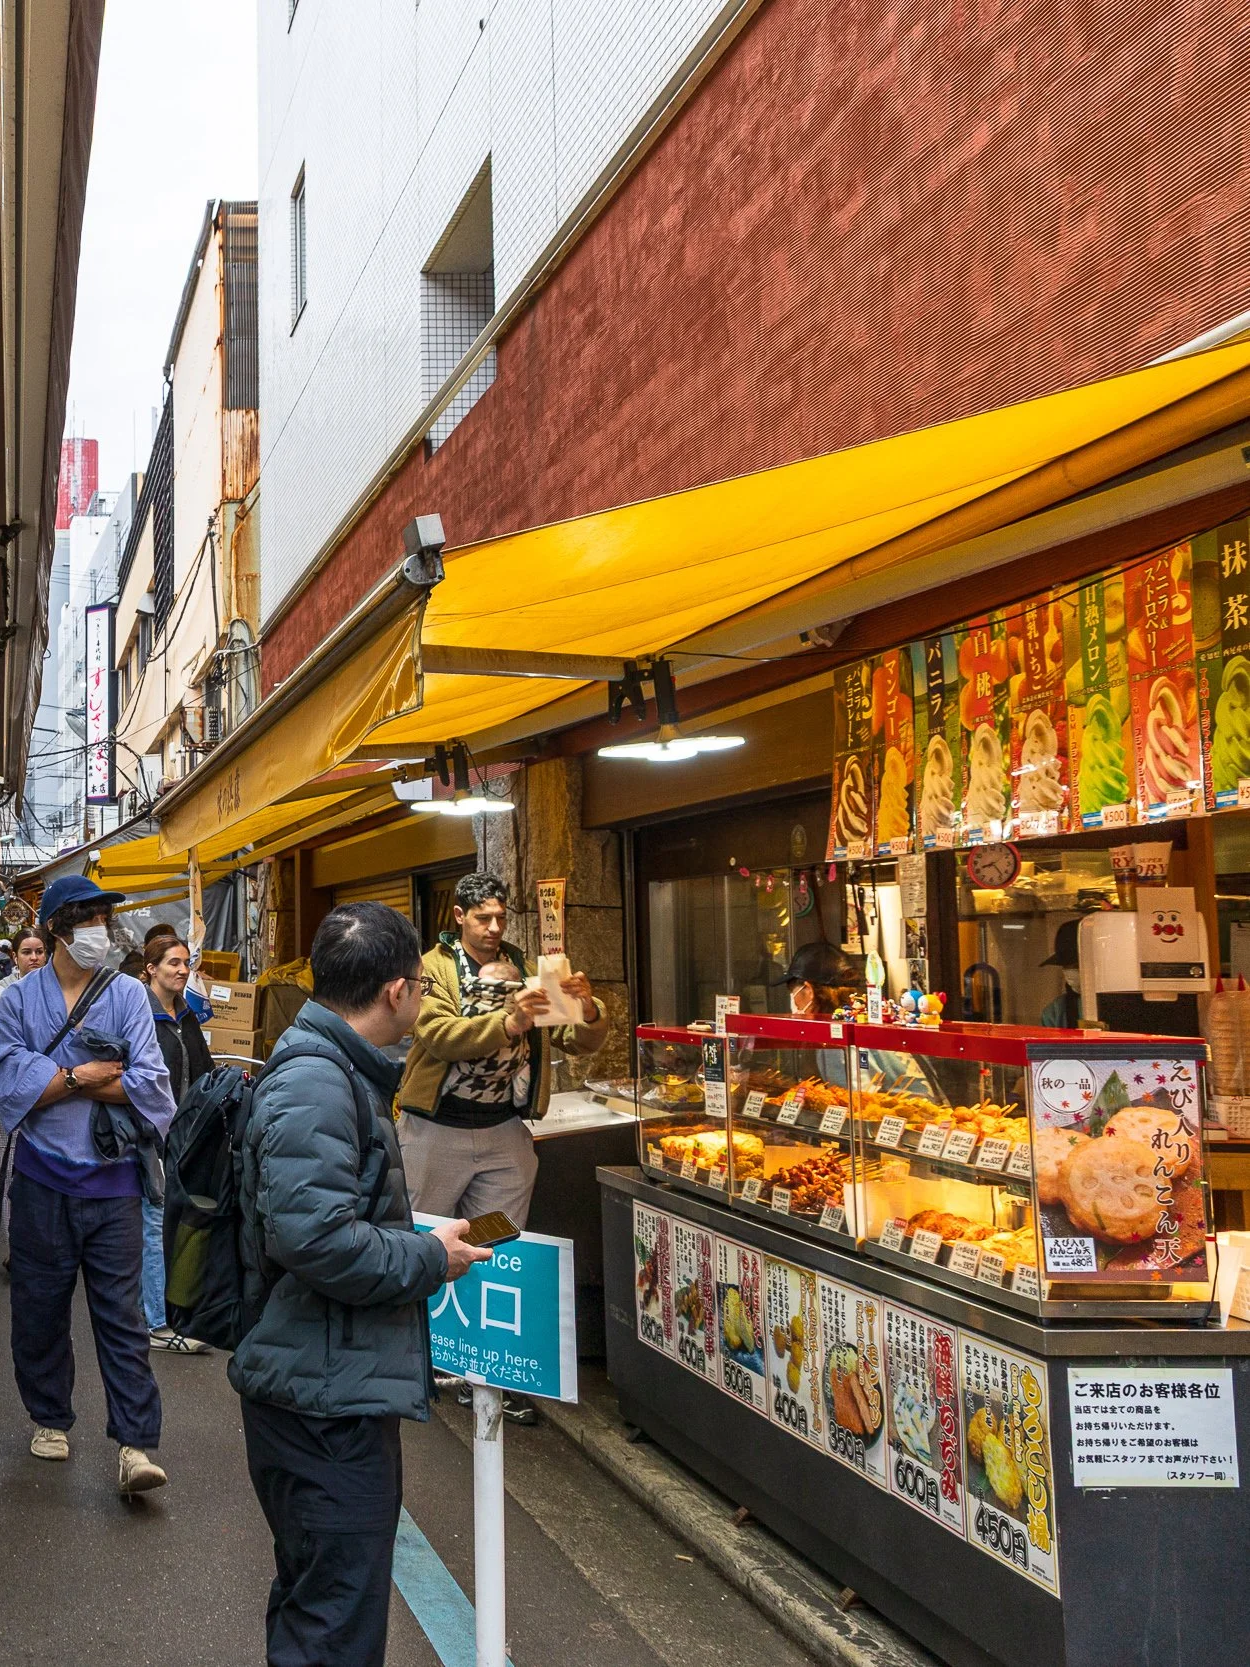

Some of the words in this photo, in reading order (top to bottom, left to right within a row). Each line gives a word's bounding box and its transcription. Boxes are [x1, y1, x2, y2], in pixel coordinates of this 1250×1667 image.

[1221, 540, 1249, 631] 抹茶
[1143, 567, 1159, 667] ストロベリー
[928, 642, 942, 716] バニラ
[974, 631, 992, 698] 白桃
[845, 674, 854, 748] チョコレート
[885, 660, 898, 736] マンゴー
[938, 833, 951, 843] ¥500
[1104, 810, 1125, 823] ¥500
[891, 841, 905, 852] ¥500
[1041, 1077, 1091, 1090] 秋の一品
[1170, 1060, 1194, 1165] えび入り
[1152, 1128, 1182, 1264] れんこん天
[1050, 1246, 1091, 1254] れんこん天
[1054, 1239, 1085, 1247] えび入り
[1071, 1258, 1093, 1267] 480円
[430, 1280, 522, 1337] 入口
[459, 1338, 478, 1356] line
[483, 1348, 499, 1362] up
[505, 1350, 542, 1371] here.
[678, 1331, 706, 1374] 400円
[722, 1355, 753, 1404] 500円
[864, 1299, 882, 1433] サーモンカツ
[972, 1347, 981, 1391] たっぷり
[773, 1385, 808, 1439] 400円
[982, 1350, 992, 1427] とうもろこしを
[1074, 1405, 1161, 1414] 当店では全ての商品を
[1075, 1383, 1220, 1399] ご来店のお客様各位
[932, 1326, 961, 1508] 海鮮ちぢみ
[1076, 1422, 1175, 1431] お持ち帰りいただけます。
[1077, 1438, 1198, 1447] お持ち帰りをご希望のお客様は
[828, 1418, 866, 1473] 350円
[1020, 1363, 1051, 1555] もろこし揚
[1078, 1455, 1233, 1464] お気軽にスタッフまでお声がけ下さい！
[895, 1452, 940, 1516] 600円
[973, 1500, 1029, 1572] 450円
